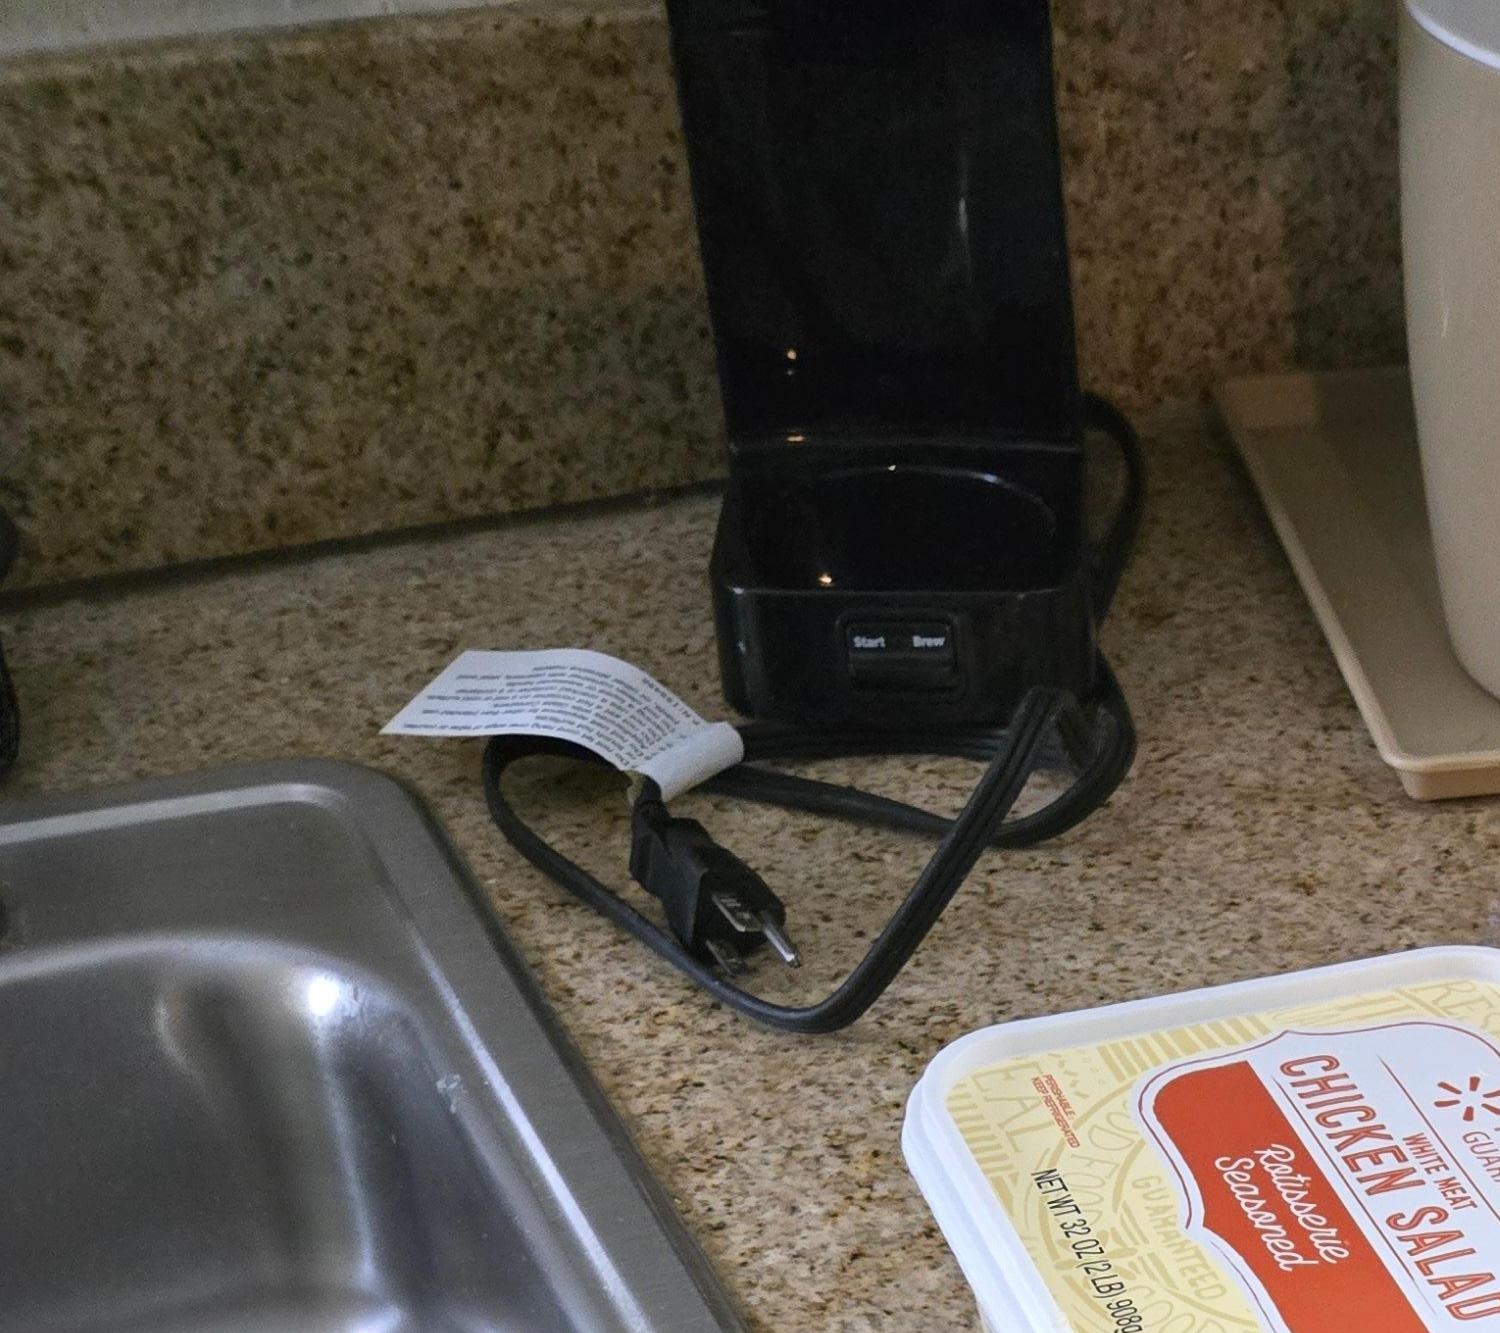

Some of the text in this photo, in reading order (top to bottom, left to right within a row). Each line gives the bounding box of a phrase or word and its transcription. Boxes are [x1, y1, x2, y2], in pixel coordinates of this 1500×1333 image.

[1279, 1054, 1427, 1197] CHICKEN
[1030, 1168, 1069, 1195] NET
[1403, 1132, 1480, 1211] WHITE MEAT
[1046, 1193, 1082, 1217] WT
[1214, 1156, 1320, 1272] Seasoned
[1253, 1143, 1350, 1264] Rotisserie
[1059, 1218, 1092, 1239] 32
[1071, 1238, 1105, 1260] OZ
[1075, 1259, 1113, 1280] (2
[1090, 1274, 1127, 1299] LB)
